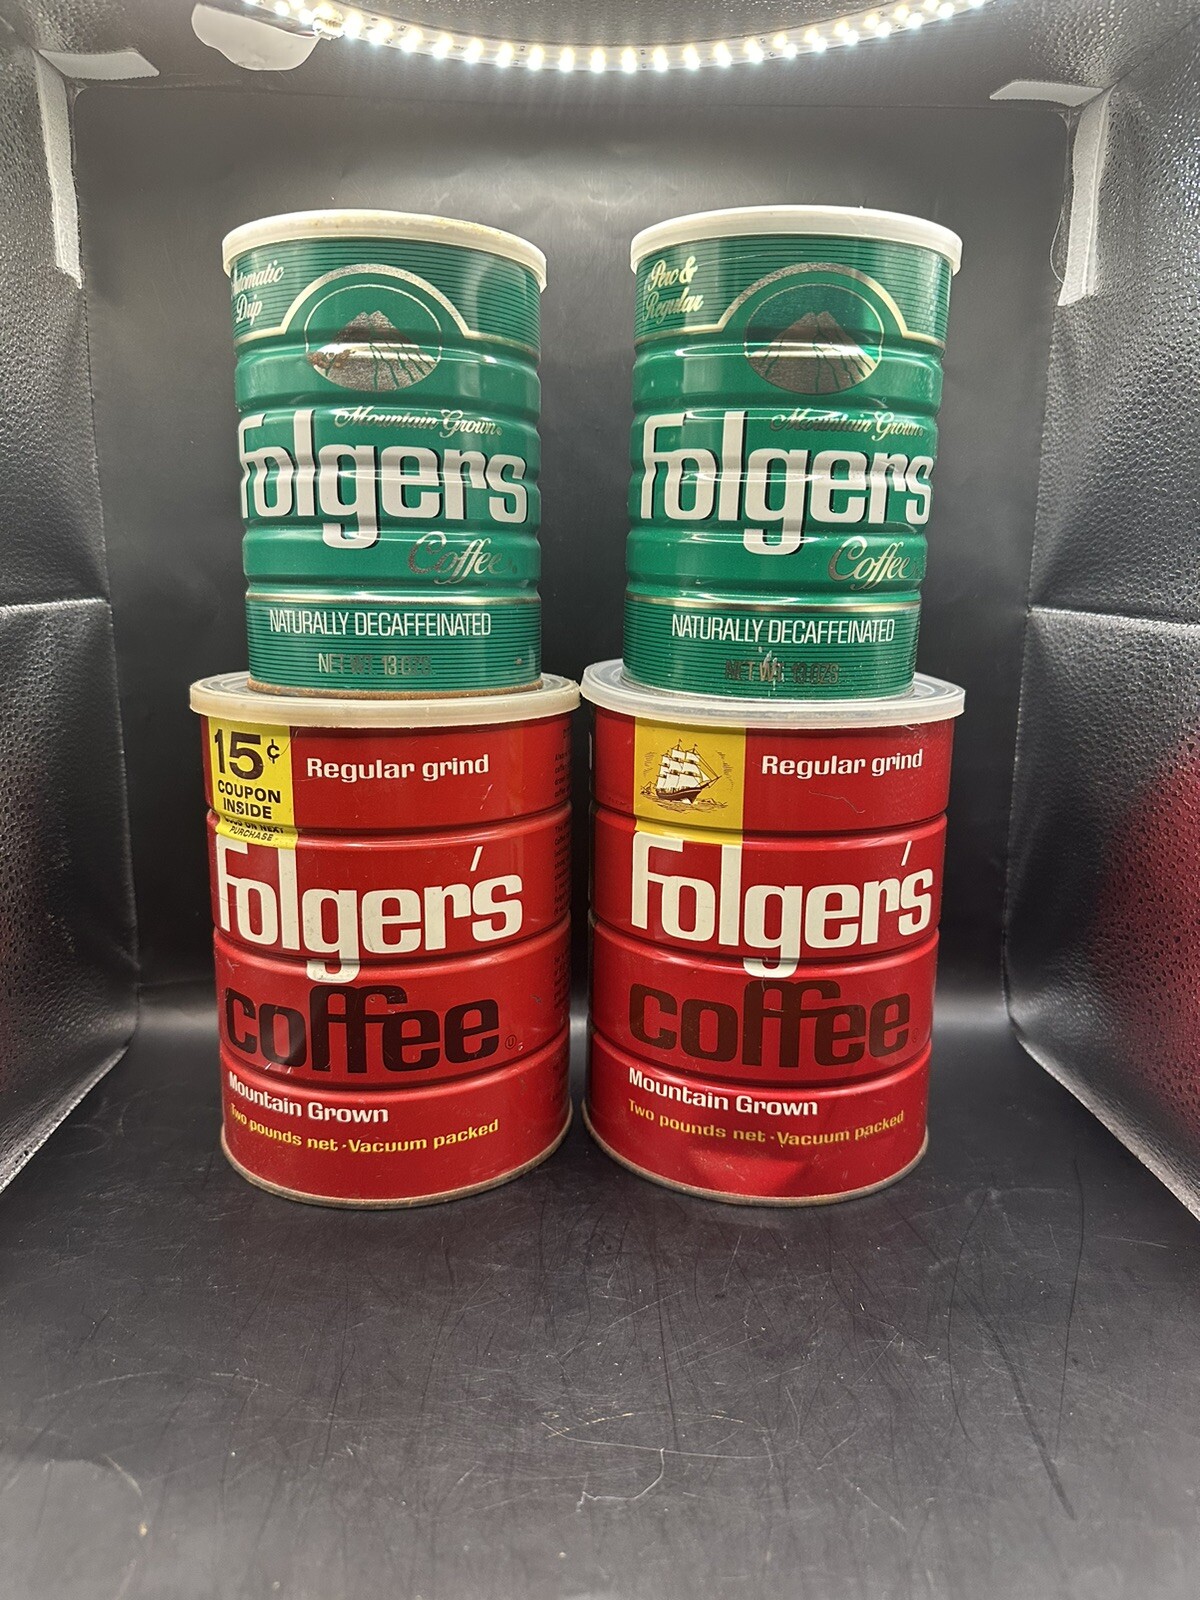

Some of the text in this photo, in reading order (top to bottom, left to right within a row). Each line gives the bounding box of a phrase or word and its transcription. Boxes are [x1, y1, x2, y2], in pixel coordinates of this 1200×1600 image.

[679, 256, 699, 284] &
[236, 294, 263, 326] Drip
[643, 286, 704, 325] Regular
[334, 405, 438, 429] Mountain
[770, 408, 872, 433] Mountain
[238, 409, 528, 549] Folgers
[640, 410, 934, 556] Folgers
[408, 531, 509, 585] Coffee
[828, 536, 916, 591] Coffee
[269, 609, 492, 637] NATURALLY DECAFFEINATED
[671, 613, 896, 645] NATURALLY DECAFFEINATED
[318, 652, 345, 674] NET
[382, 655, 398, 676] 13
[306, 753, 490, 783] Regular grind
[761, 748, 924, 779] Regular grind
[217, 779, 281, 804] COUPON
[223, 797, 272, 820] INSIDE
[229, 825, 274, 842] PURCHASE
[214, 834, 523, 983] Folger's
[631, 831, 934, 979] Folger's
[225, 984, 500, 1074] coffee
[629, 979, 911, 1069] coffee
[228, 1071, 390, 1124] Mountain Grown
[629, 1066, 819, 1116] Mountain Grown
[230, 1102, 248, 1126] Two
[249, 1119, 303, 1146] pounds
[433, 1118, 500, 1150] packed
[629, 1098, 655, 1121] Two
[659, 1113, 727, 1139] pounds
[854, 1109, 905, 1141] packed
